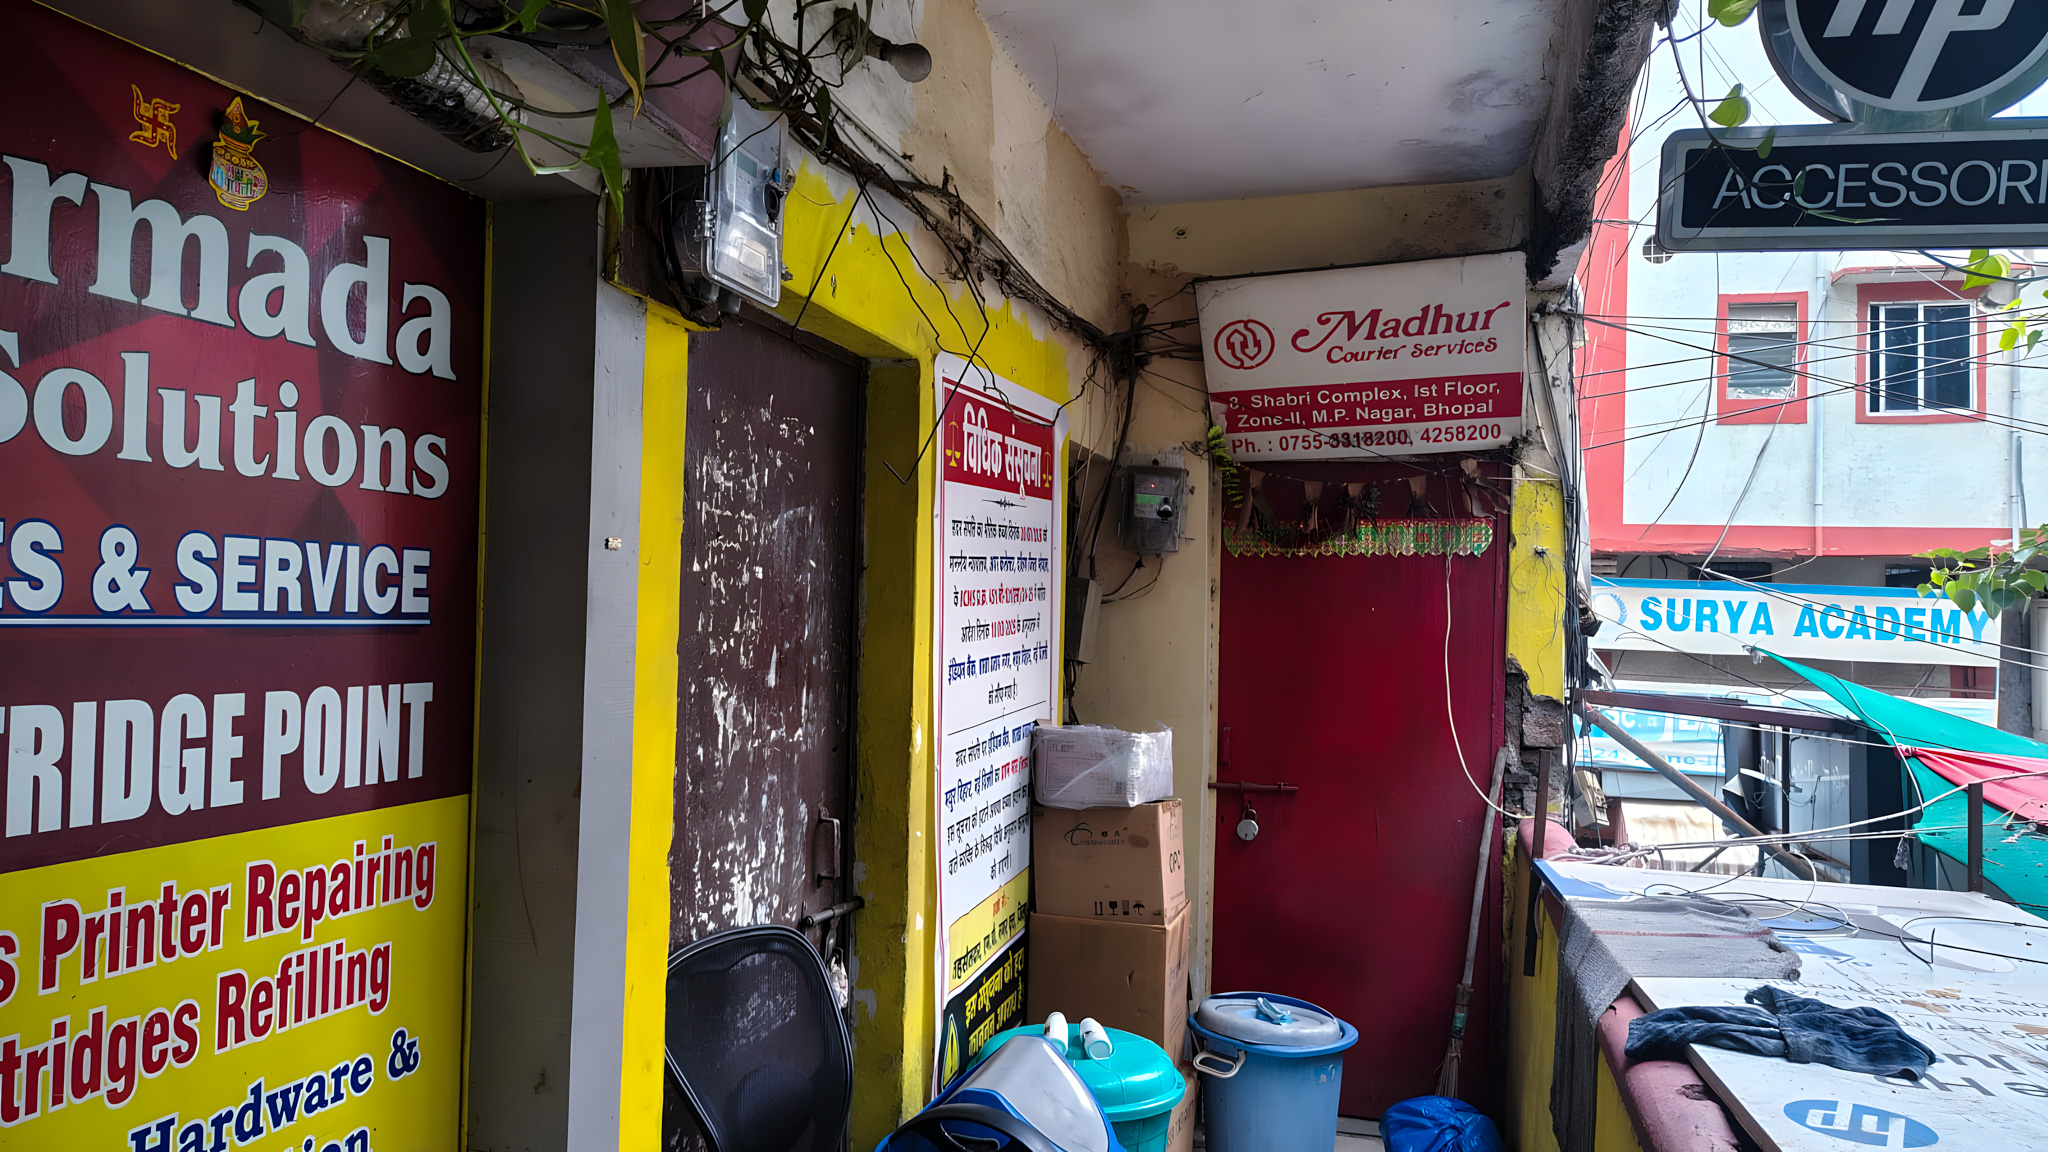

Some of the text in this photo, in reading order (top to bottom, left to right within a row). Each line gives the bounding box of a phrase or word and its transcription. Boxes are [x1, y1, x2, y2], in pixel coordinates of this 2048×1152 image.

[1290, 301, 1511, 354] Madhur
[1326, 336, 1498, 365] Courier Services
[1250, 391, 1311, 409] Shabri
[1317, 387, 1408, 406] Complex,
[1444, 380, 1501, 396] Floor,
[1312, 408, 1350, 424] M.P.
[1355, 404, 1417, 422] Nagar,
[1423, 399, 1494, 417] Bhopal
[962, 402, 1042, 500] विधिक संसूचना
[1231, 438, 1261, 455] Ph.
[1419, 423, 1502, 443] 4258200
[0, 518, 432, 617] S & SERVICE
[1639, 596, 1990, 646] SURYA ACADEMY
[0, 681, 434, 838] RIDGE POINT
[38, 881, 232, 996] Printer
[243, 834, 438, 944] Repairing
[0, 938, 393, 1128] tridges Refilling
[965, 995, 976, 1030] इस
[128, 1026, 420, 1152] Hardware &
